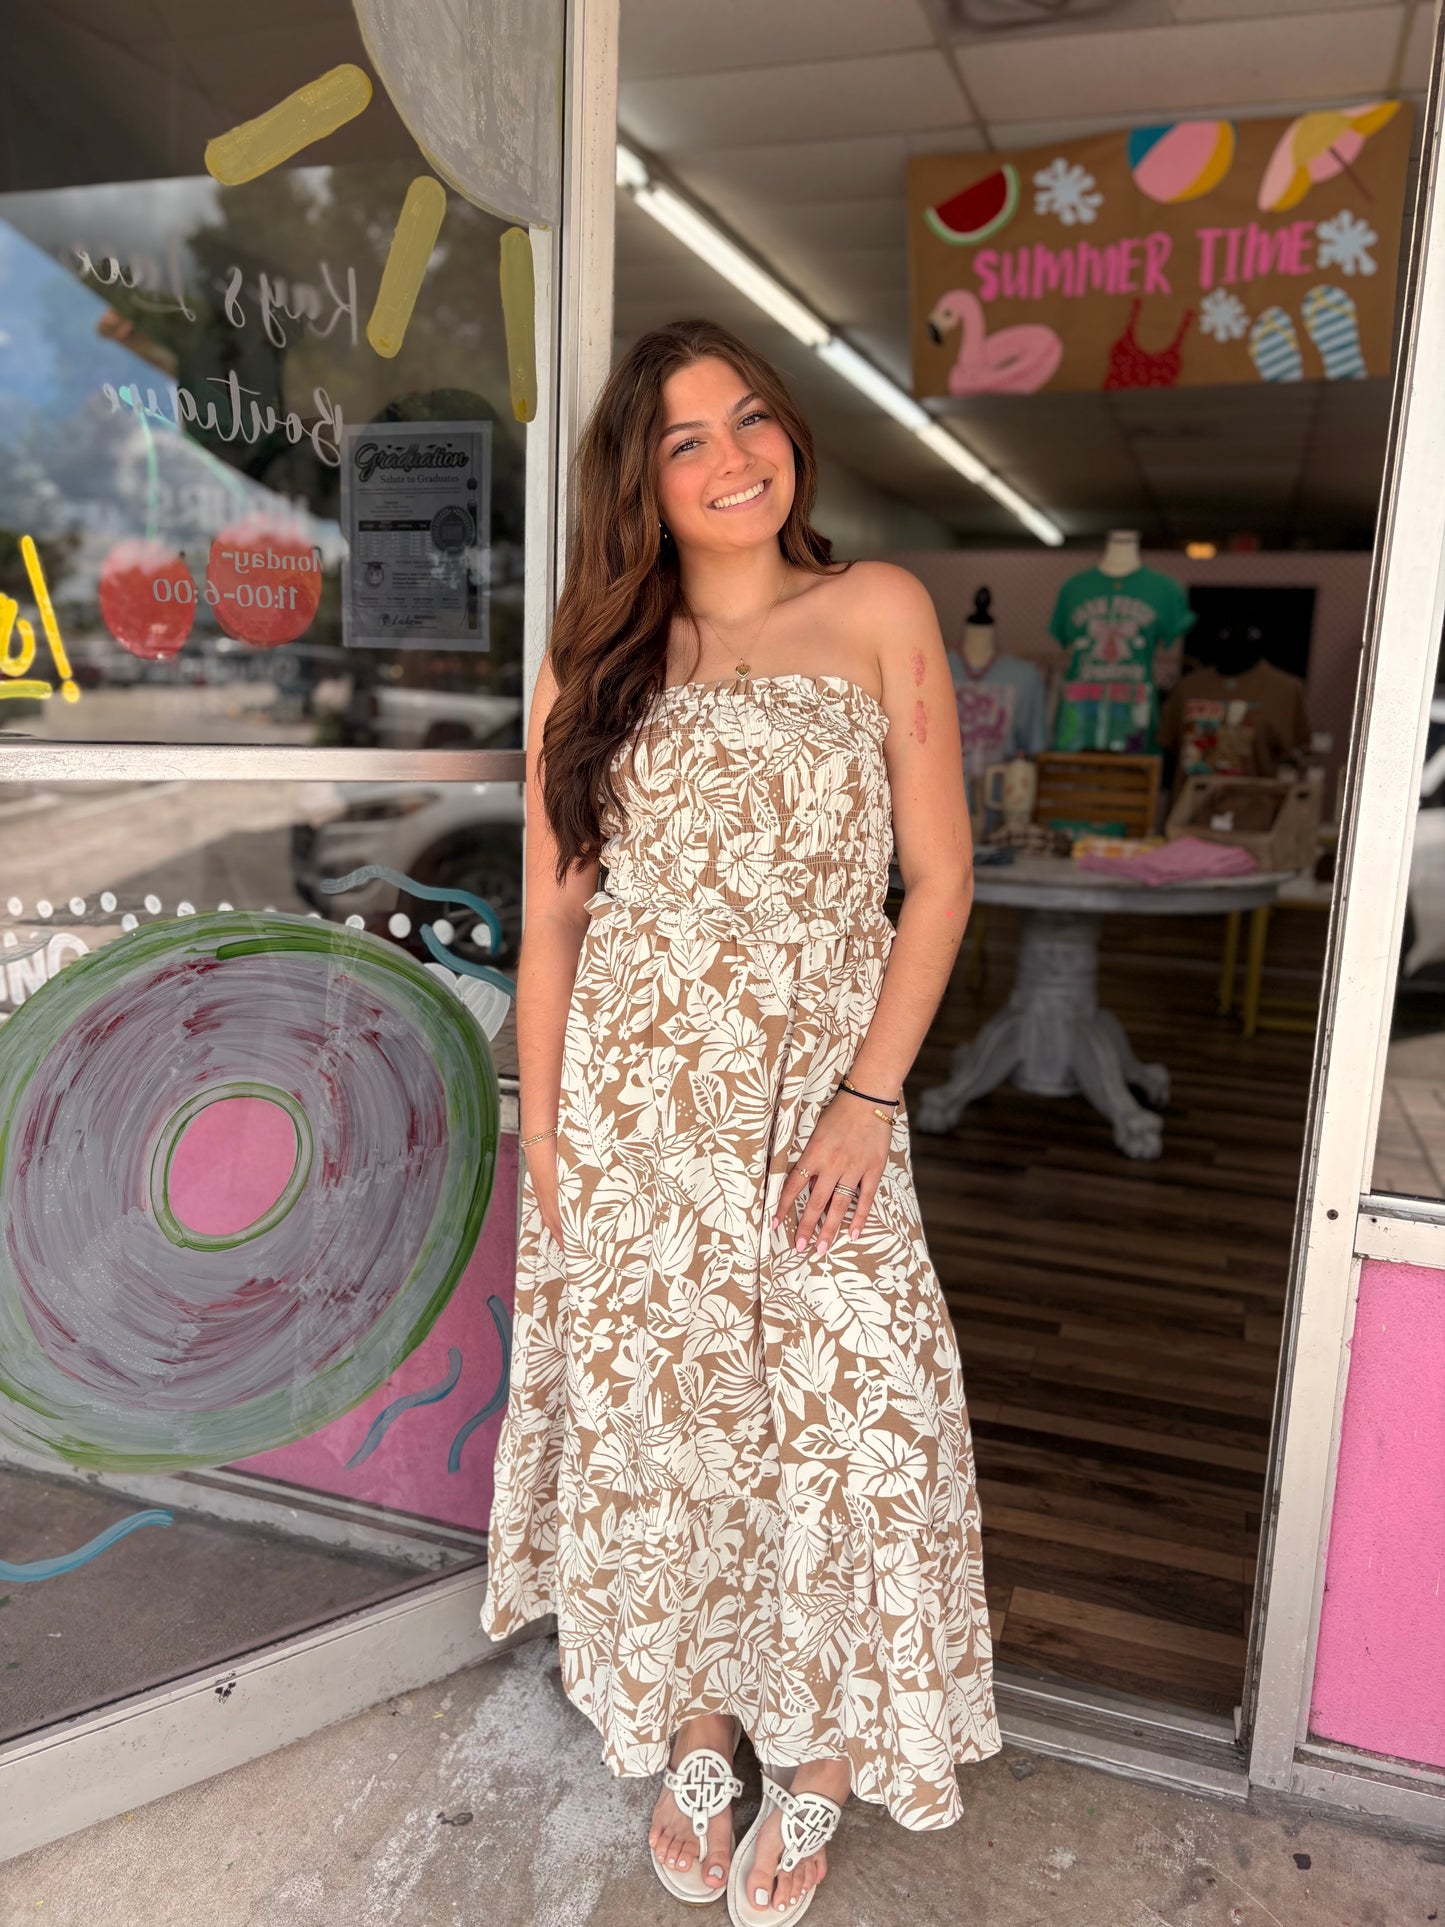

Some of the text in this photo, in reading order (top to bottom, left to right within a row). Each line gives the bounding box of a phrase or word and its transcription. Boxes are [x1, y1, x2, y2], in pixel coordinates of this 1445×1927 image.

[974, 219, 1316, 300] SUMMER TIME
[355, 443, 470, 483] Graduation
[380, 473, 460, 484] Salute to Graduates
